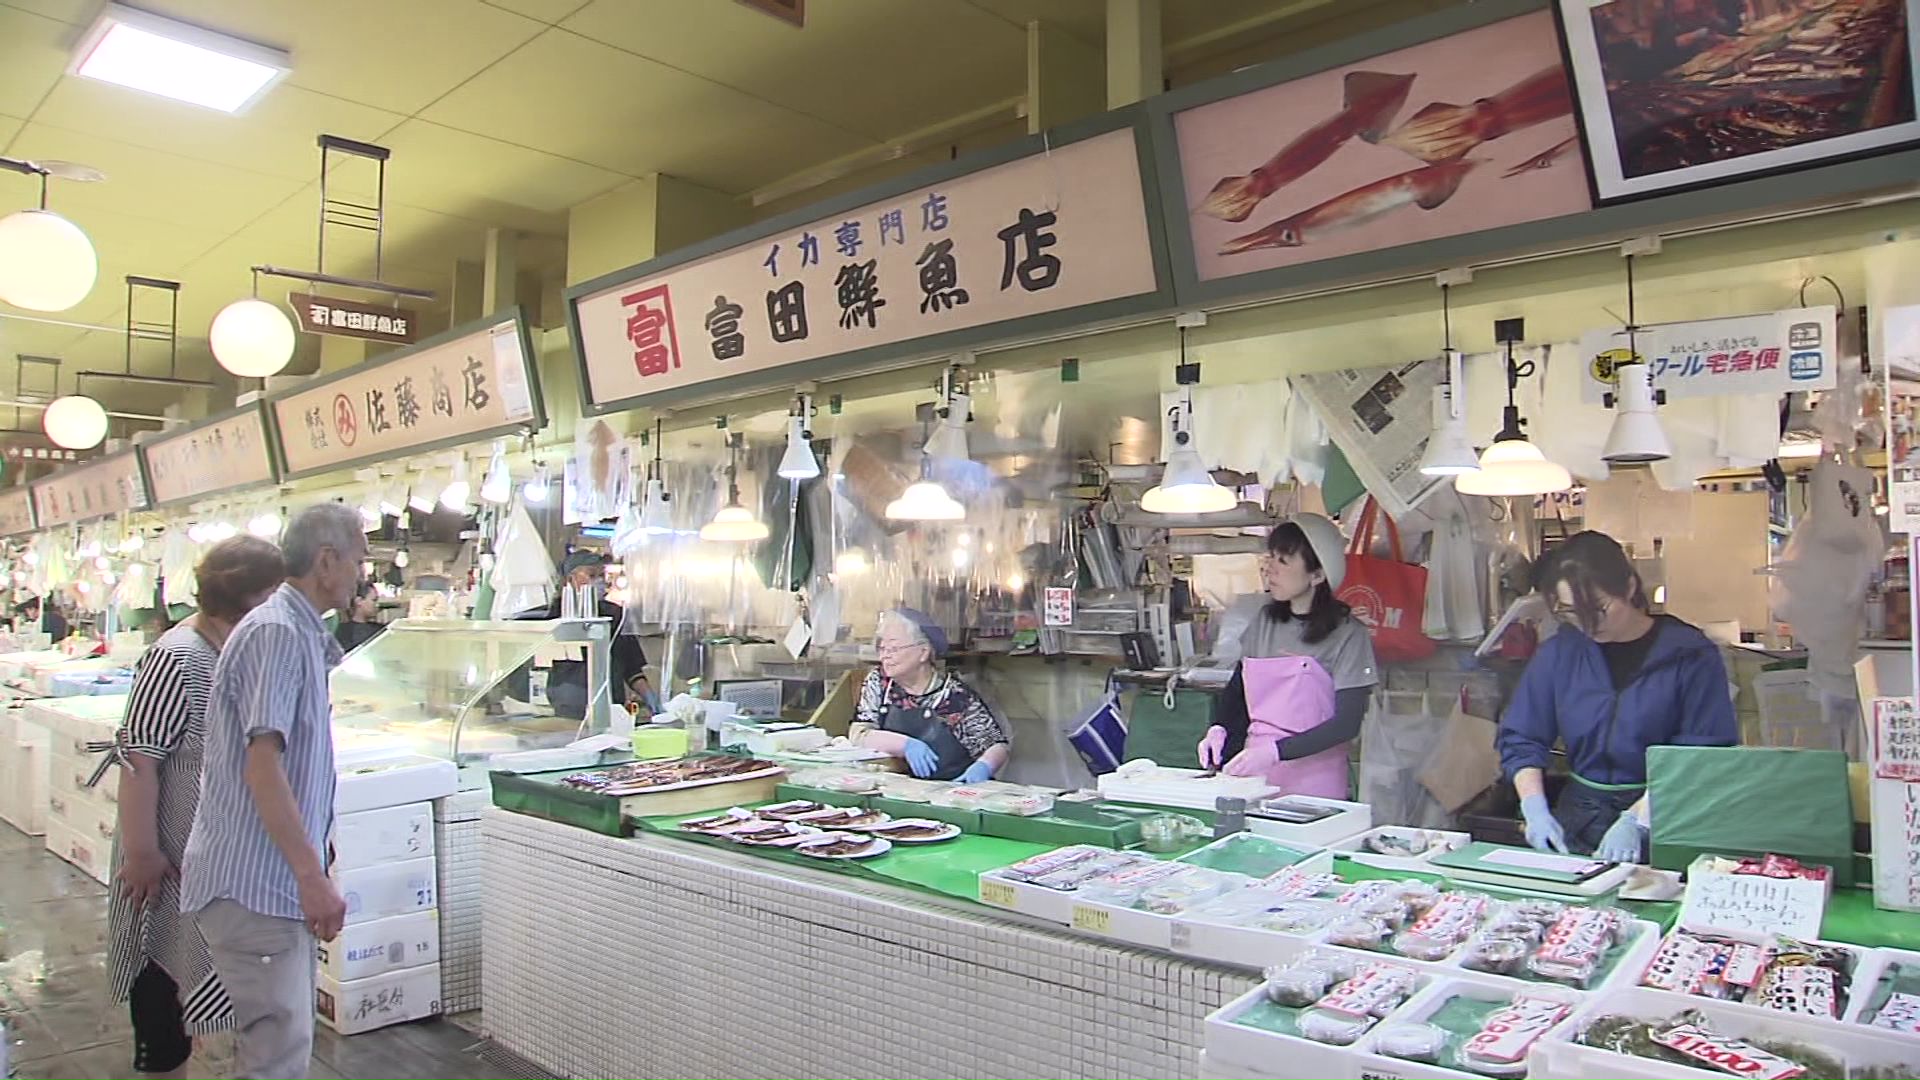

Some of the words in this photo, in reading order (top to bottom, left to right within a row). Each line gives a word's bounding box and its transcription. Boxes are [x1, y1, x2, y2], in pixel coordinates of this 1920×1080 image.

[763, 192, 949, 277] イカ専門店
[703, 207, 1063, 361] 富田鮮魚店
[365, 355, 490, 435] 佐藤商店
